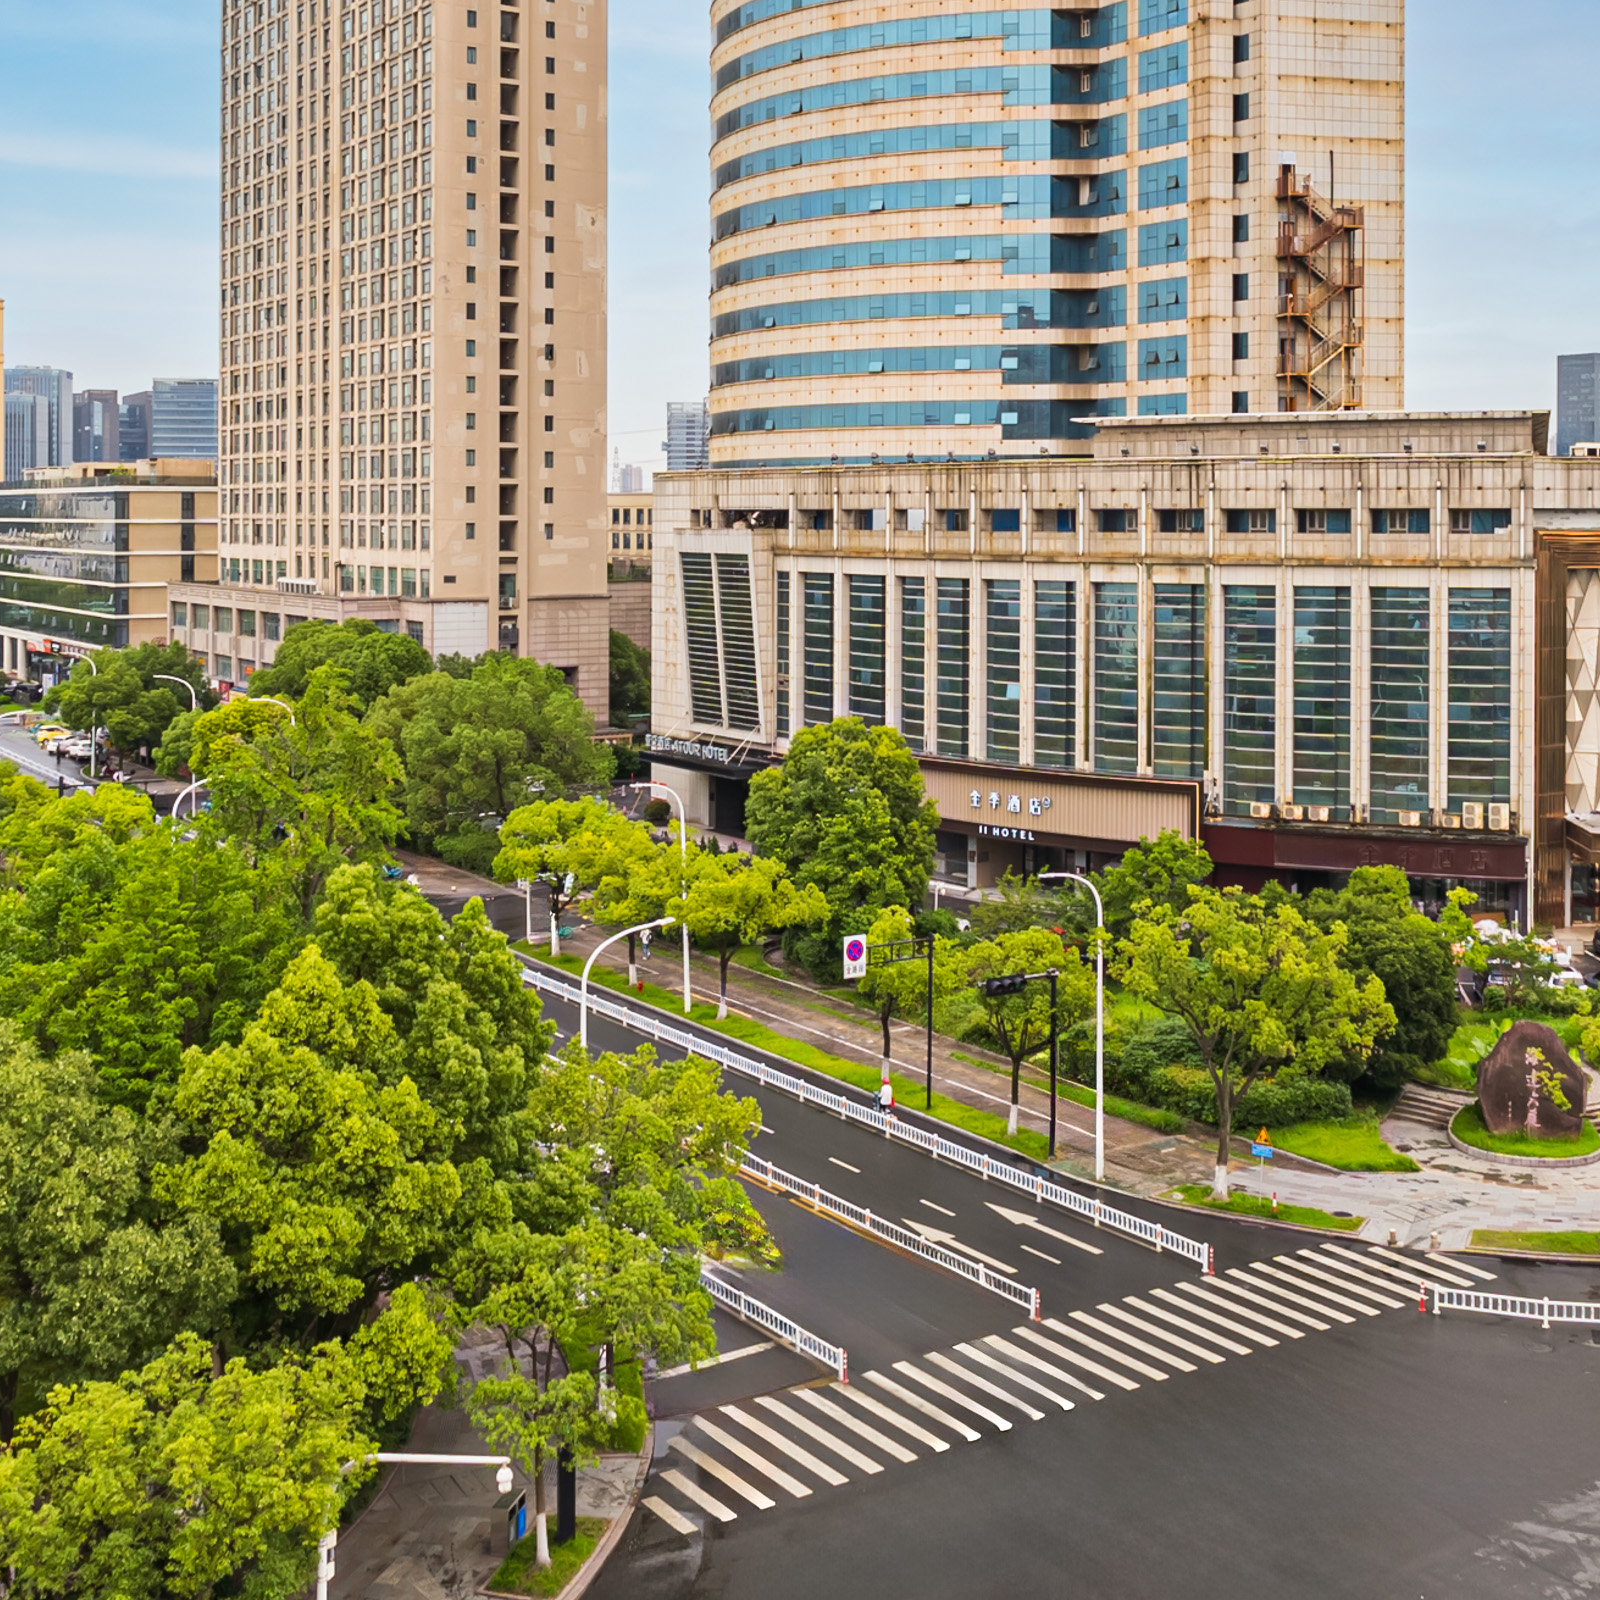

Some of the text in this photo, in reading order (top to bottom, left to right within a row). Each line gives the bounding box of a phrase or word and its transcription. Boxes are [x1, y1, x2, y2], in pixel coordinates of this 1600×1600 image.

[672, 739, 701, 757] ATOUR
[969, 789, 1041, 815] 全季酒店
[992, 826, 1035, 841] HOTEL
